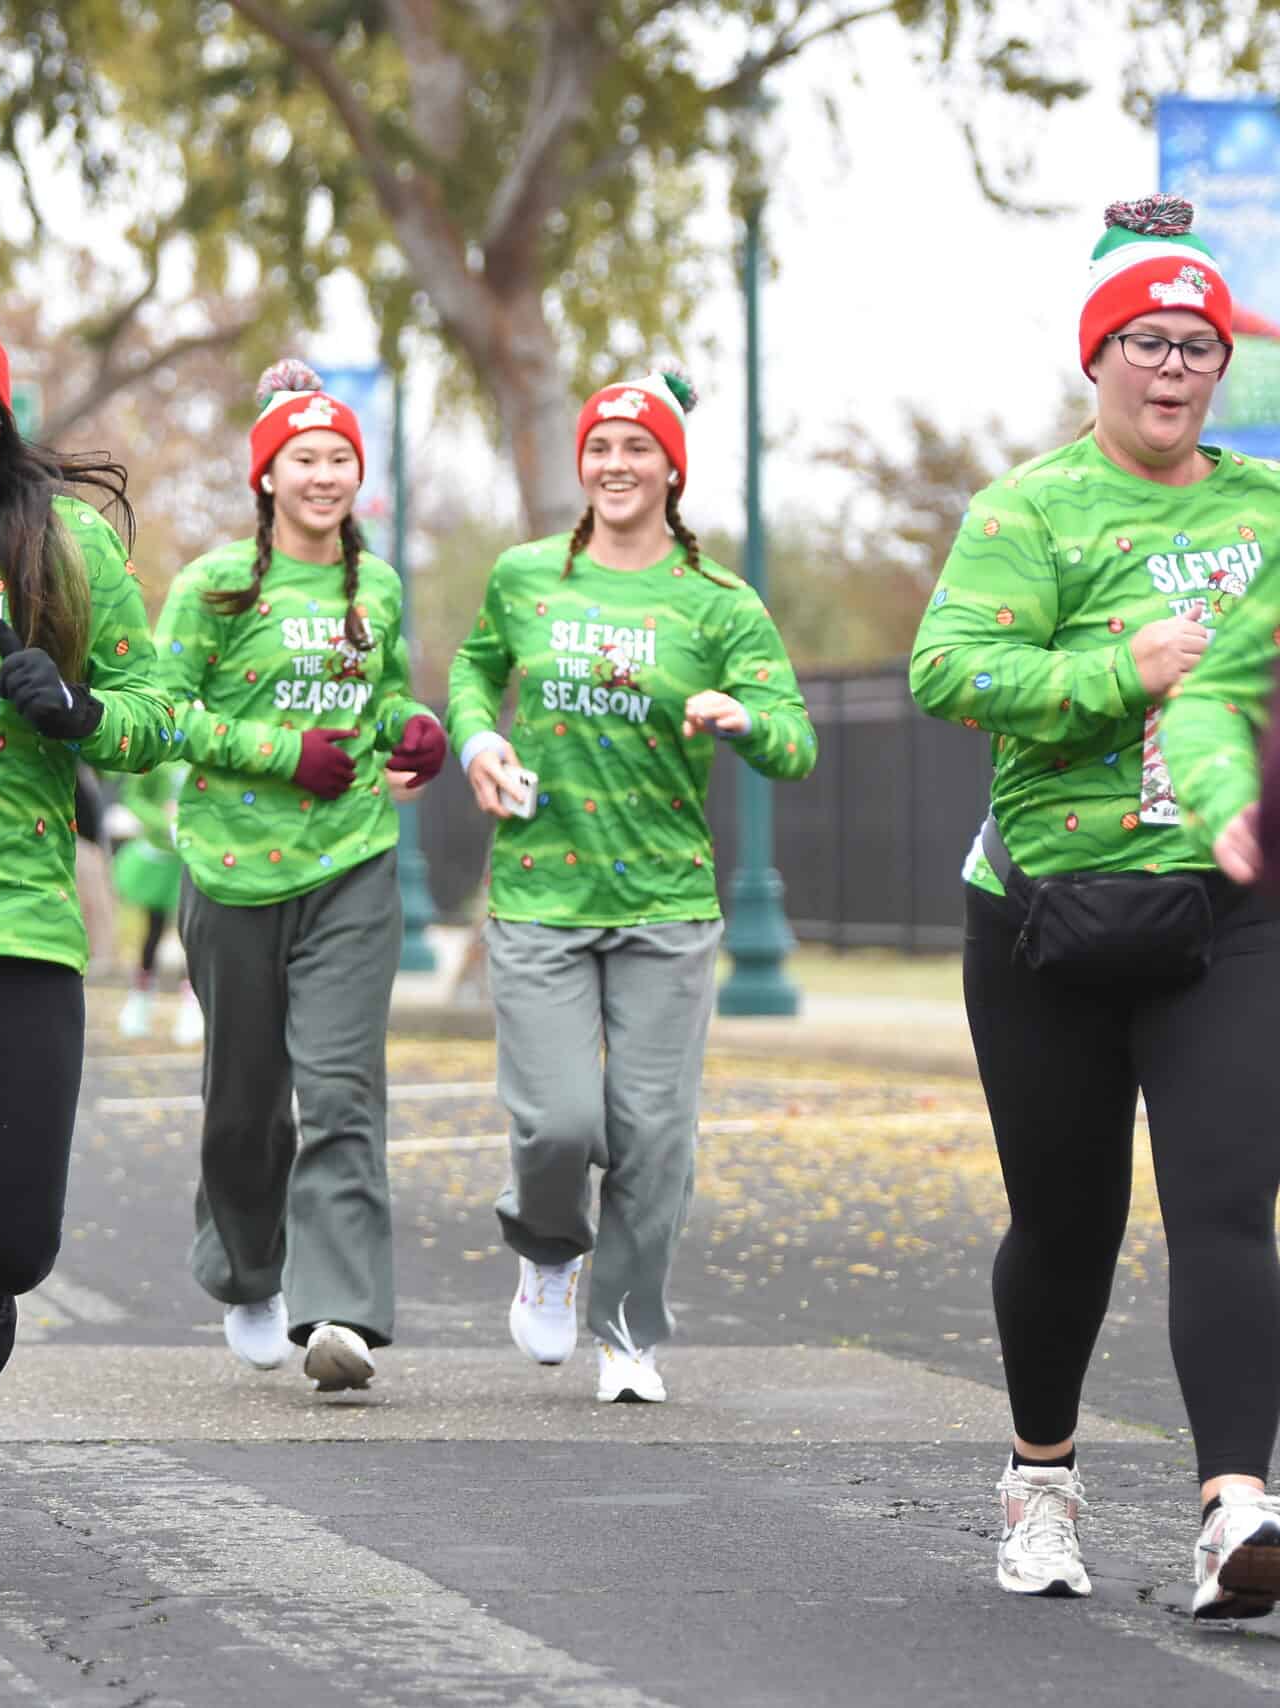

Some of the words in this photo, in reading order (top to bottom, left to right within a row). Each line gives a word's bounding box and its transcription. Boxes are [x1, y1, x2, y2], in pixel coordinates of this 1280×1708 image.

[1147, 542, 1263, 594] SLEIGH
[281, 616, 375, 651] SLEI
[549, 620, 657, 666] SLEIGH
[292, 655, 324, 676] THE
[556, 656, 591, 679] THE
[274, 679, 373, 715] SEASON
[542, 680, 652, 723] SEASON
